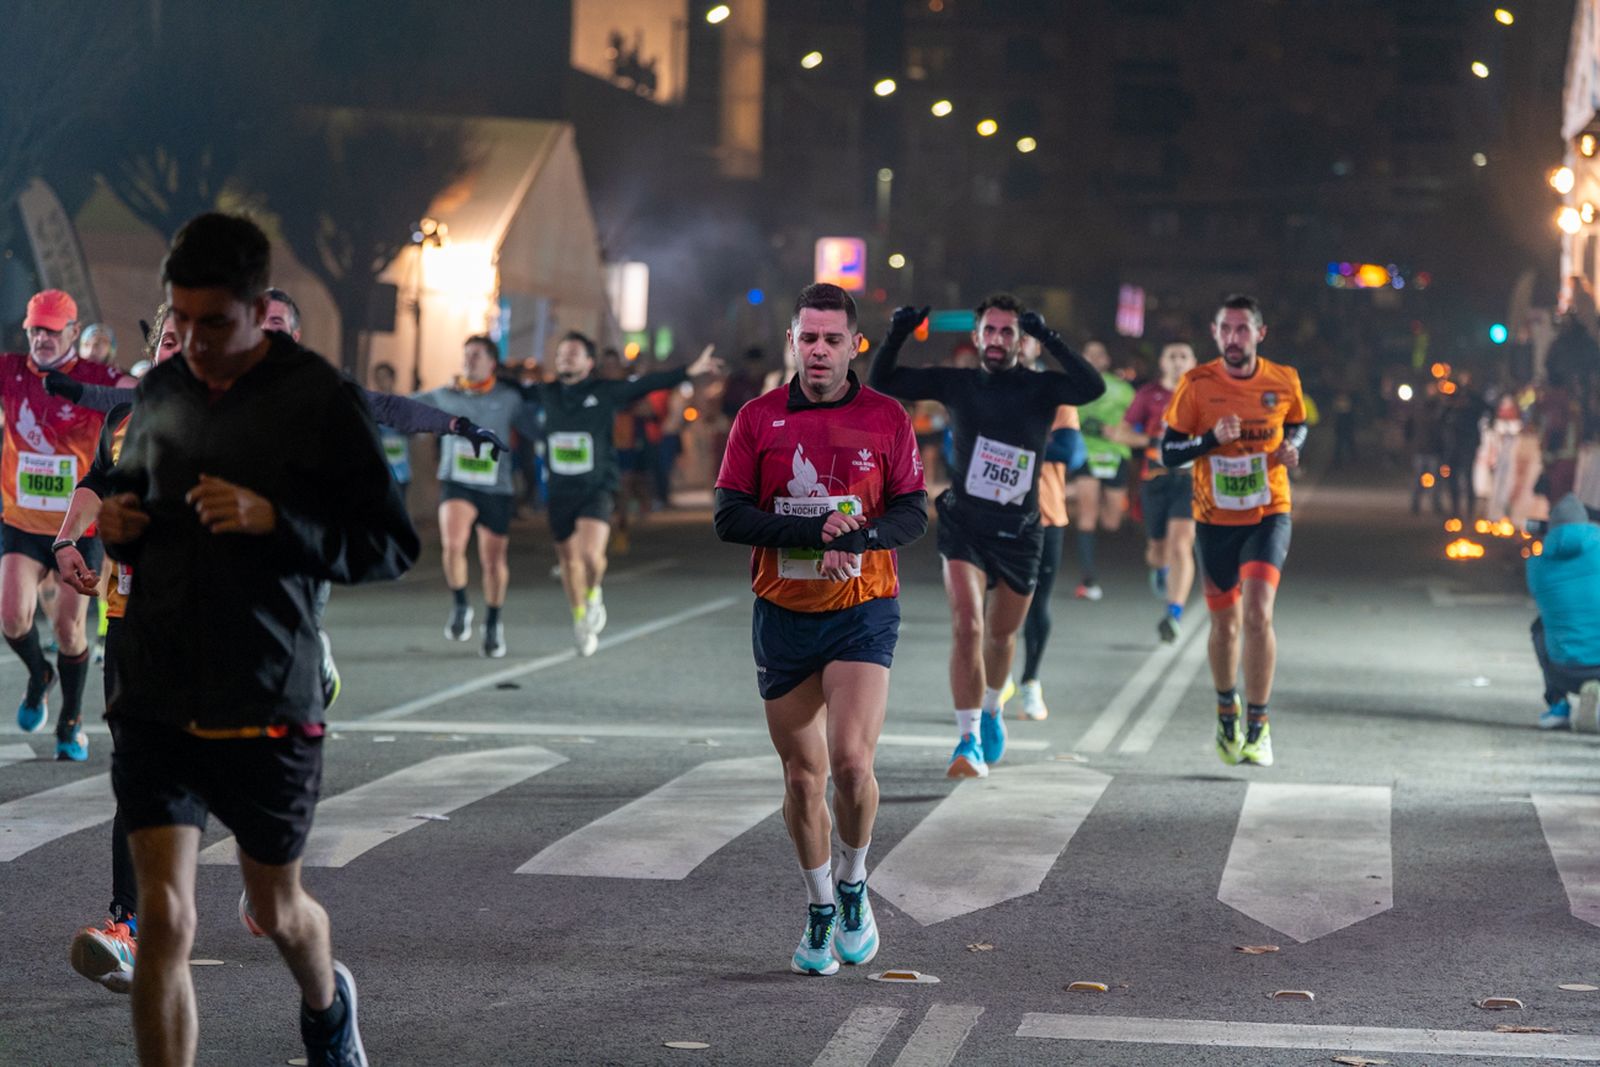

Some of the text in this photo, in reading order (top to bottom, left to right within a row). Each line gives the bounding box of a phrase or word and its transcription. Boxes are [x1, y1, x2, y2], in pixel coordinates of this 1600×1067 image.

[982, 461, 1020, 487] 7563
[1223, 474, 1257, 491] 1326
[28, 474, 64, 492] 1603
[792, 506, 817, 515] NOCHE
